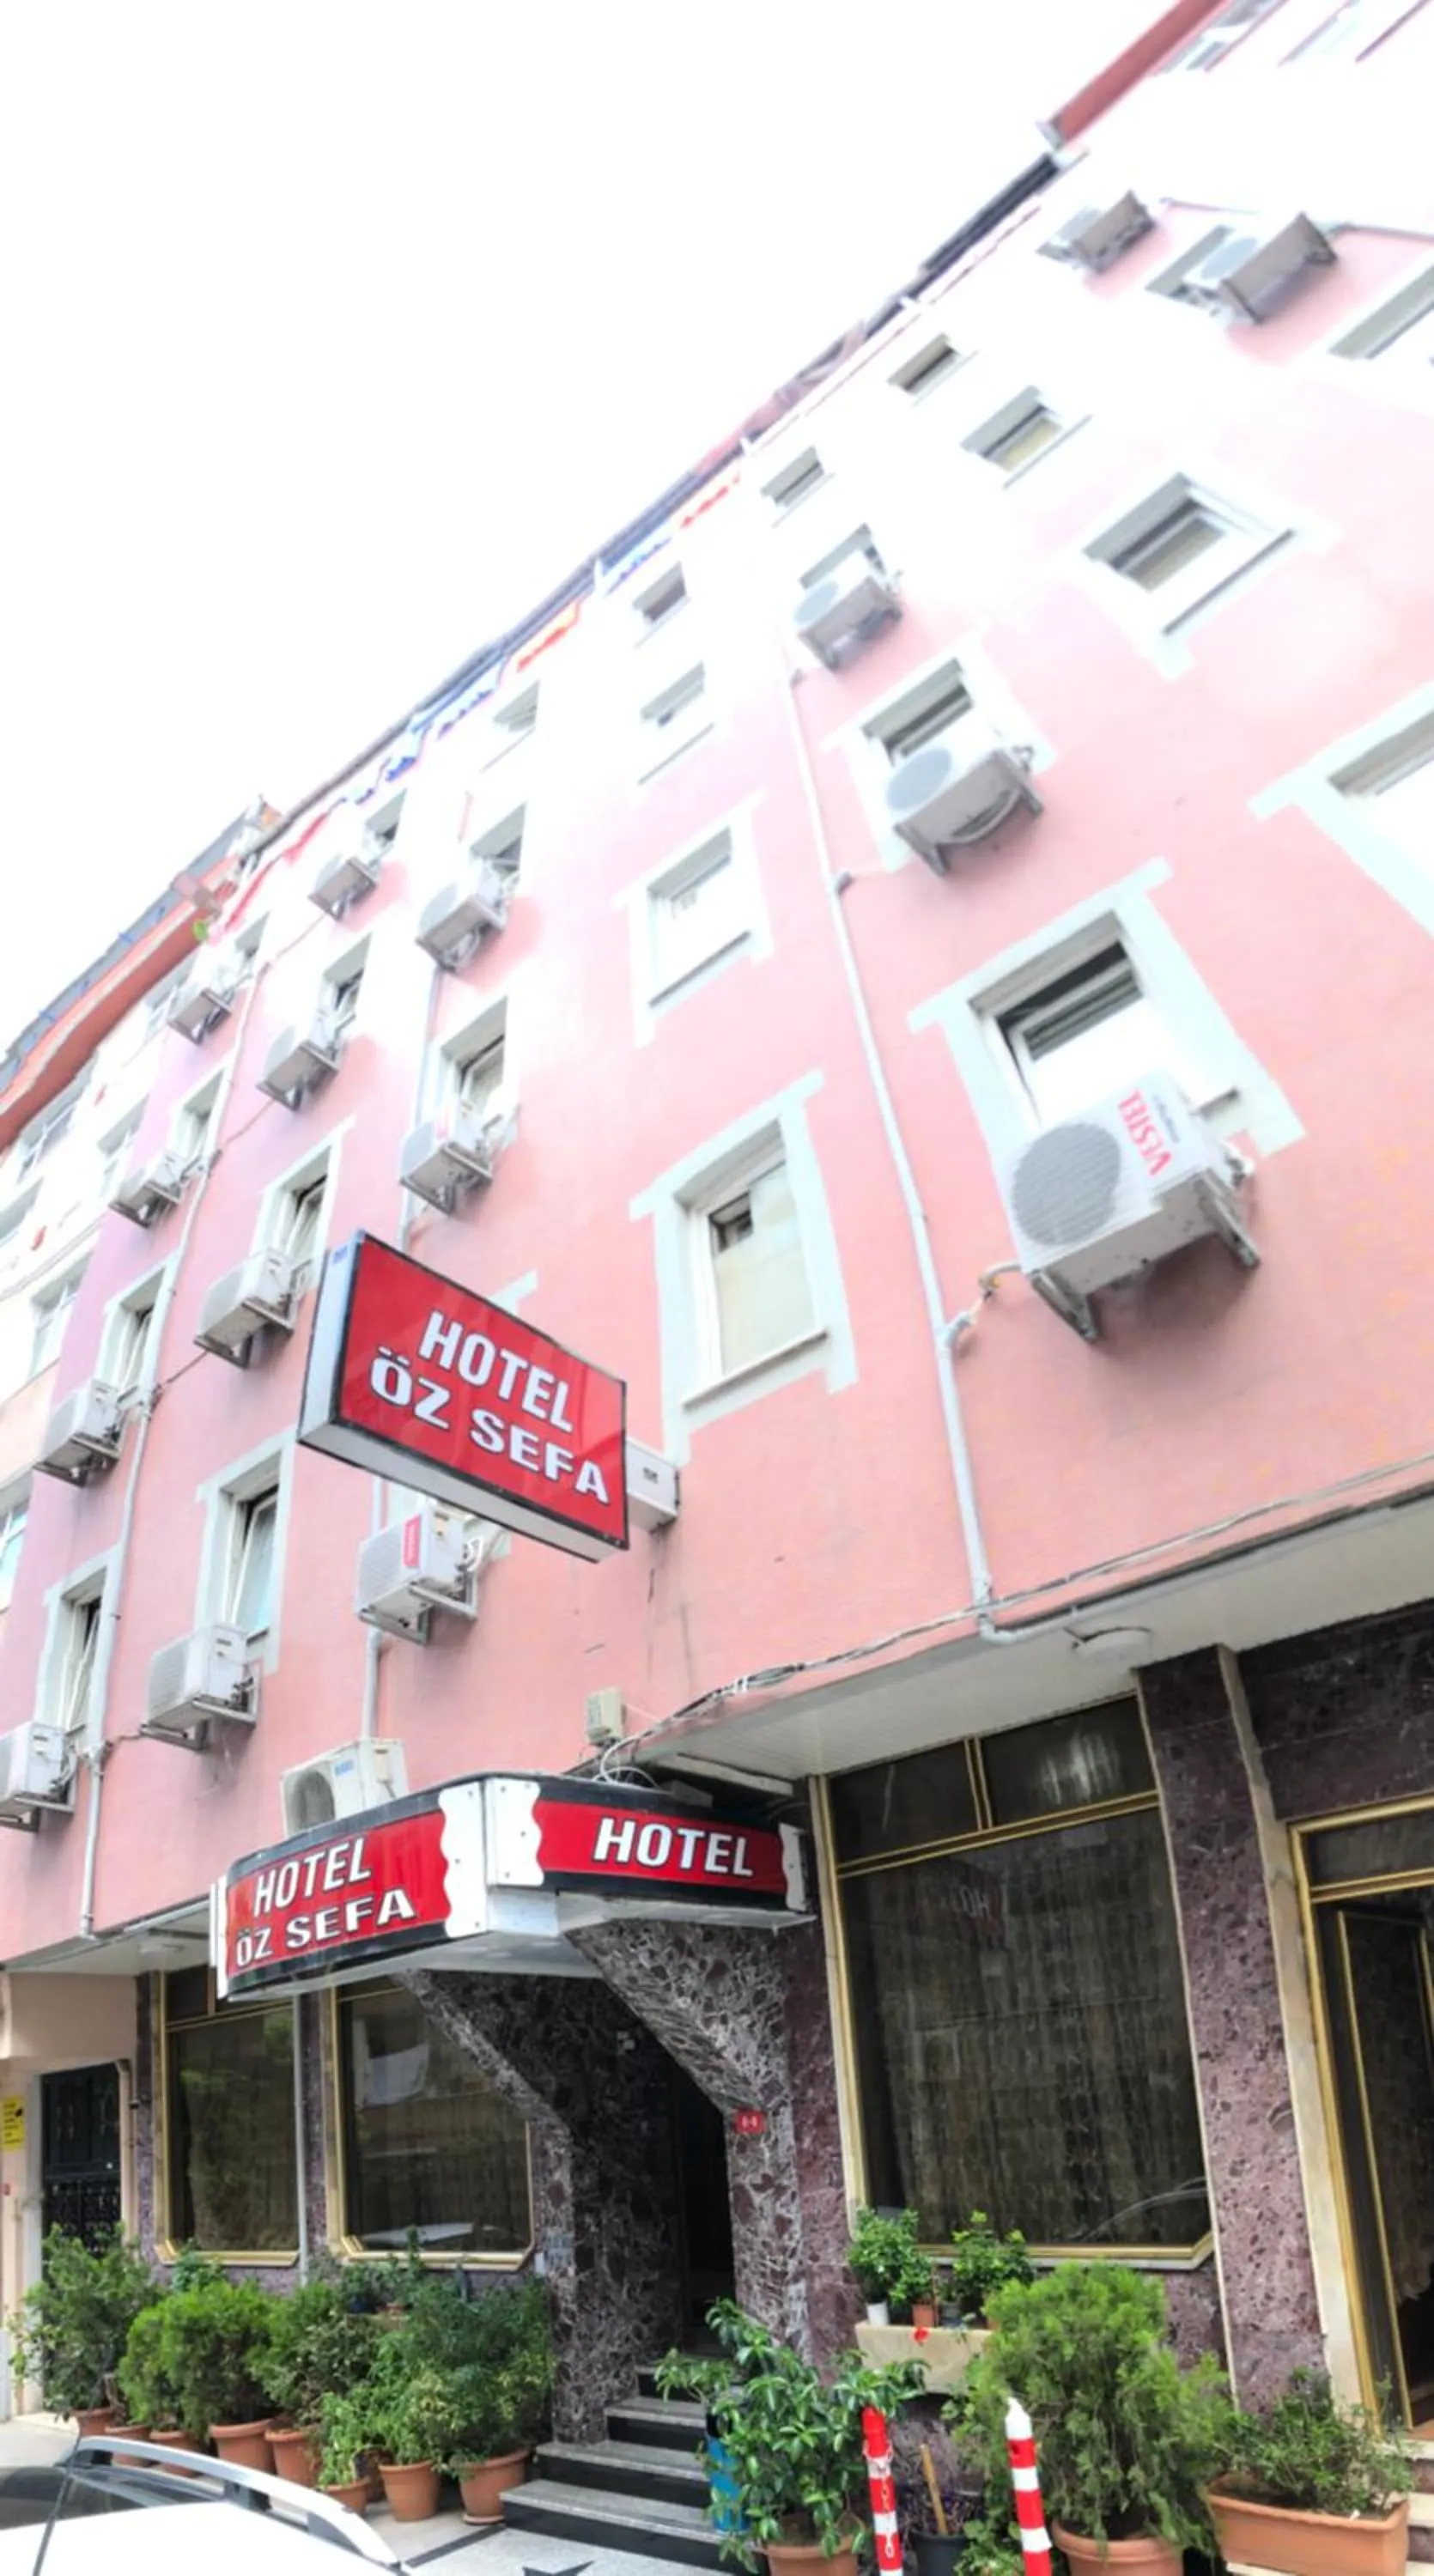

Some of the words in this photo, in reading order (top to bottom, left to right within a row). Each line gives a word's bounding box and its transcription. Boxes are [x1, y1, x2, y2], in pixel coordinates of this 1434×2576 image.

[419, 1310, 573, 1432] HOTEL
[371, 1346, 451, 1429] ÖZ
[471, 1408, 609, 1504] SEFA
[253, 1837, 371, 1917] HOTEL
[593, 1817, 754, 1877] HOTEL
[236, 1929, 273, 1966] ÖZ
[286, 1889, 416, 1948] SEFA
